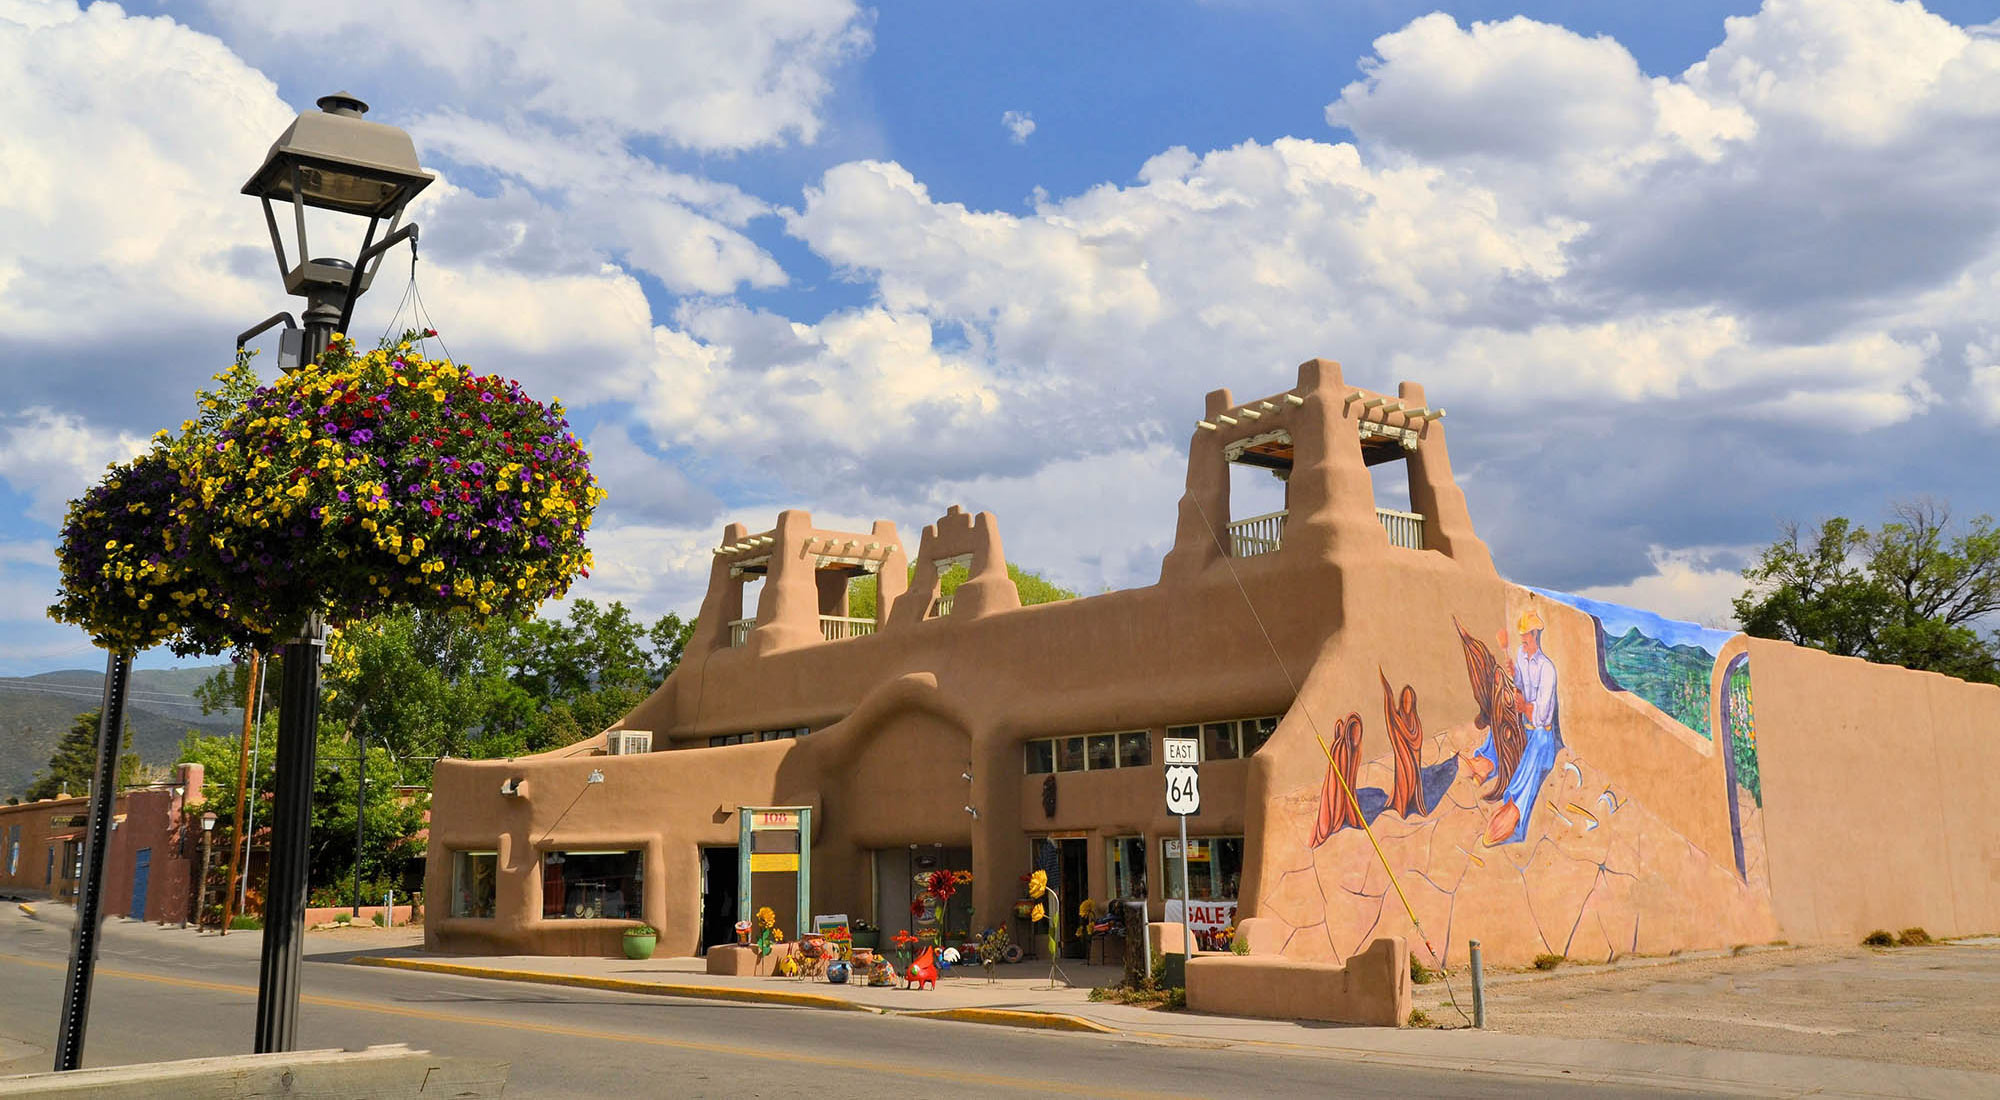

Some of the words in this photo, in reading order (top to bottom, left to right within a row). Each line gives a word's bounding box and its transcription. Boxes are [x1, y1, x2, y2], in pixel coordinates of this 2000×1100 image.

[1170, 745, 1191, 758] EAST
[1171, 776, 1193, 802] 64
[764, 813, 787, 824] 108
[1171, 841, 1193, 850] SAE
